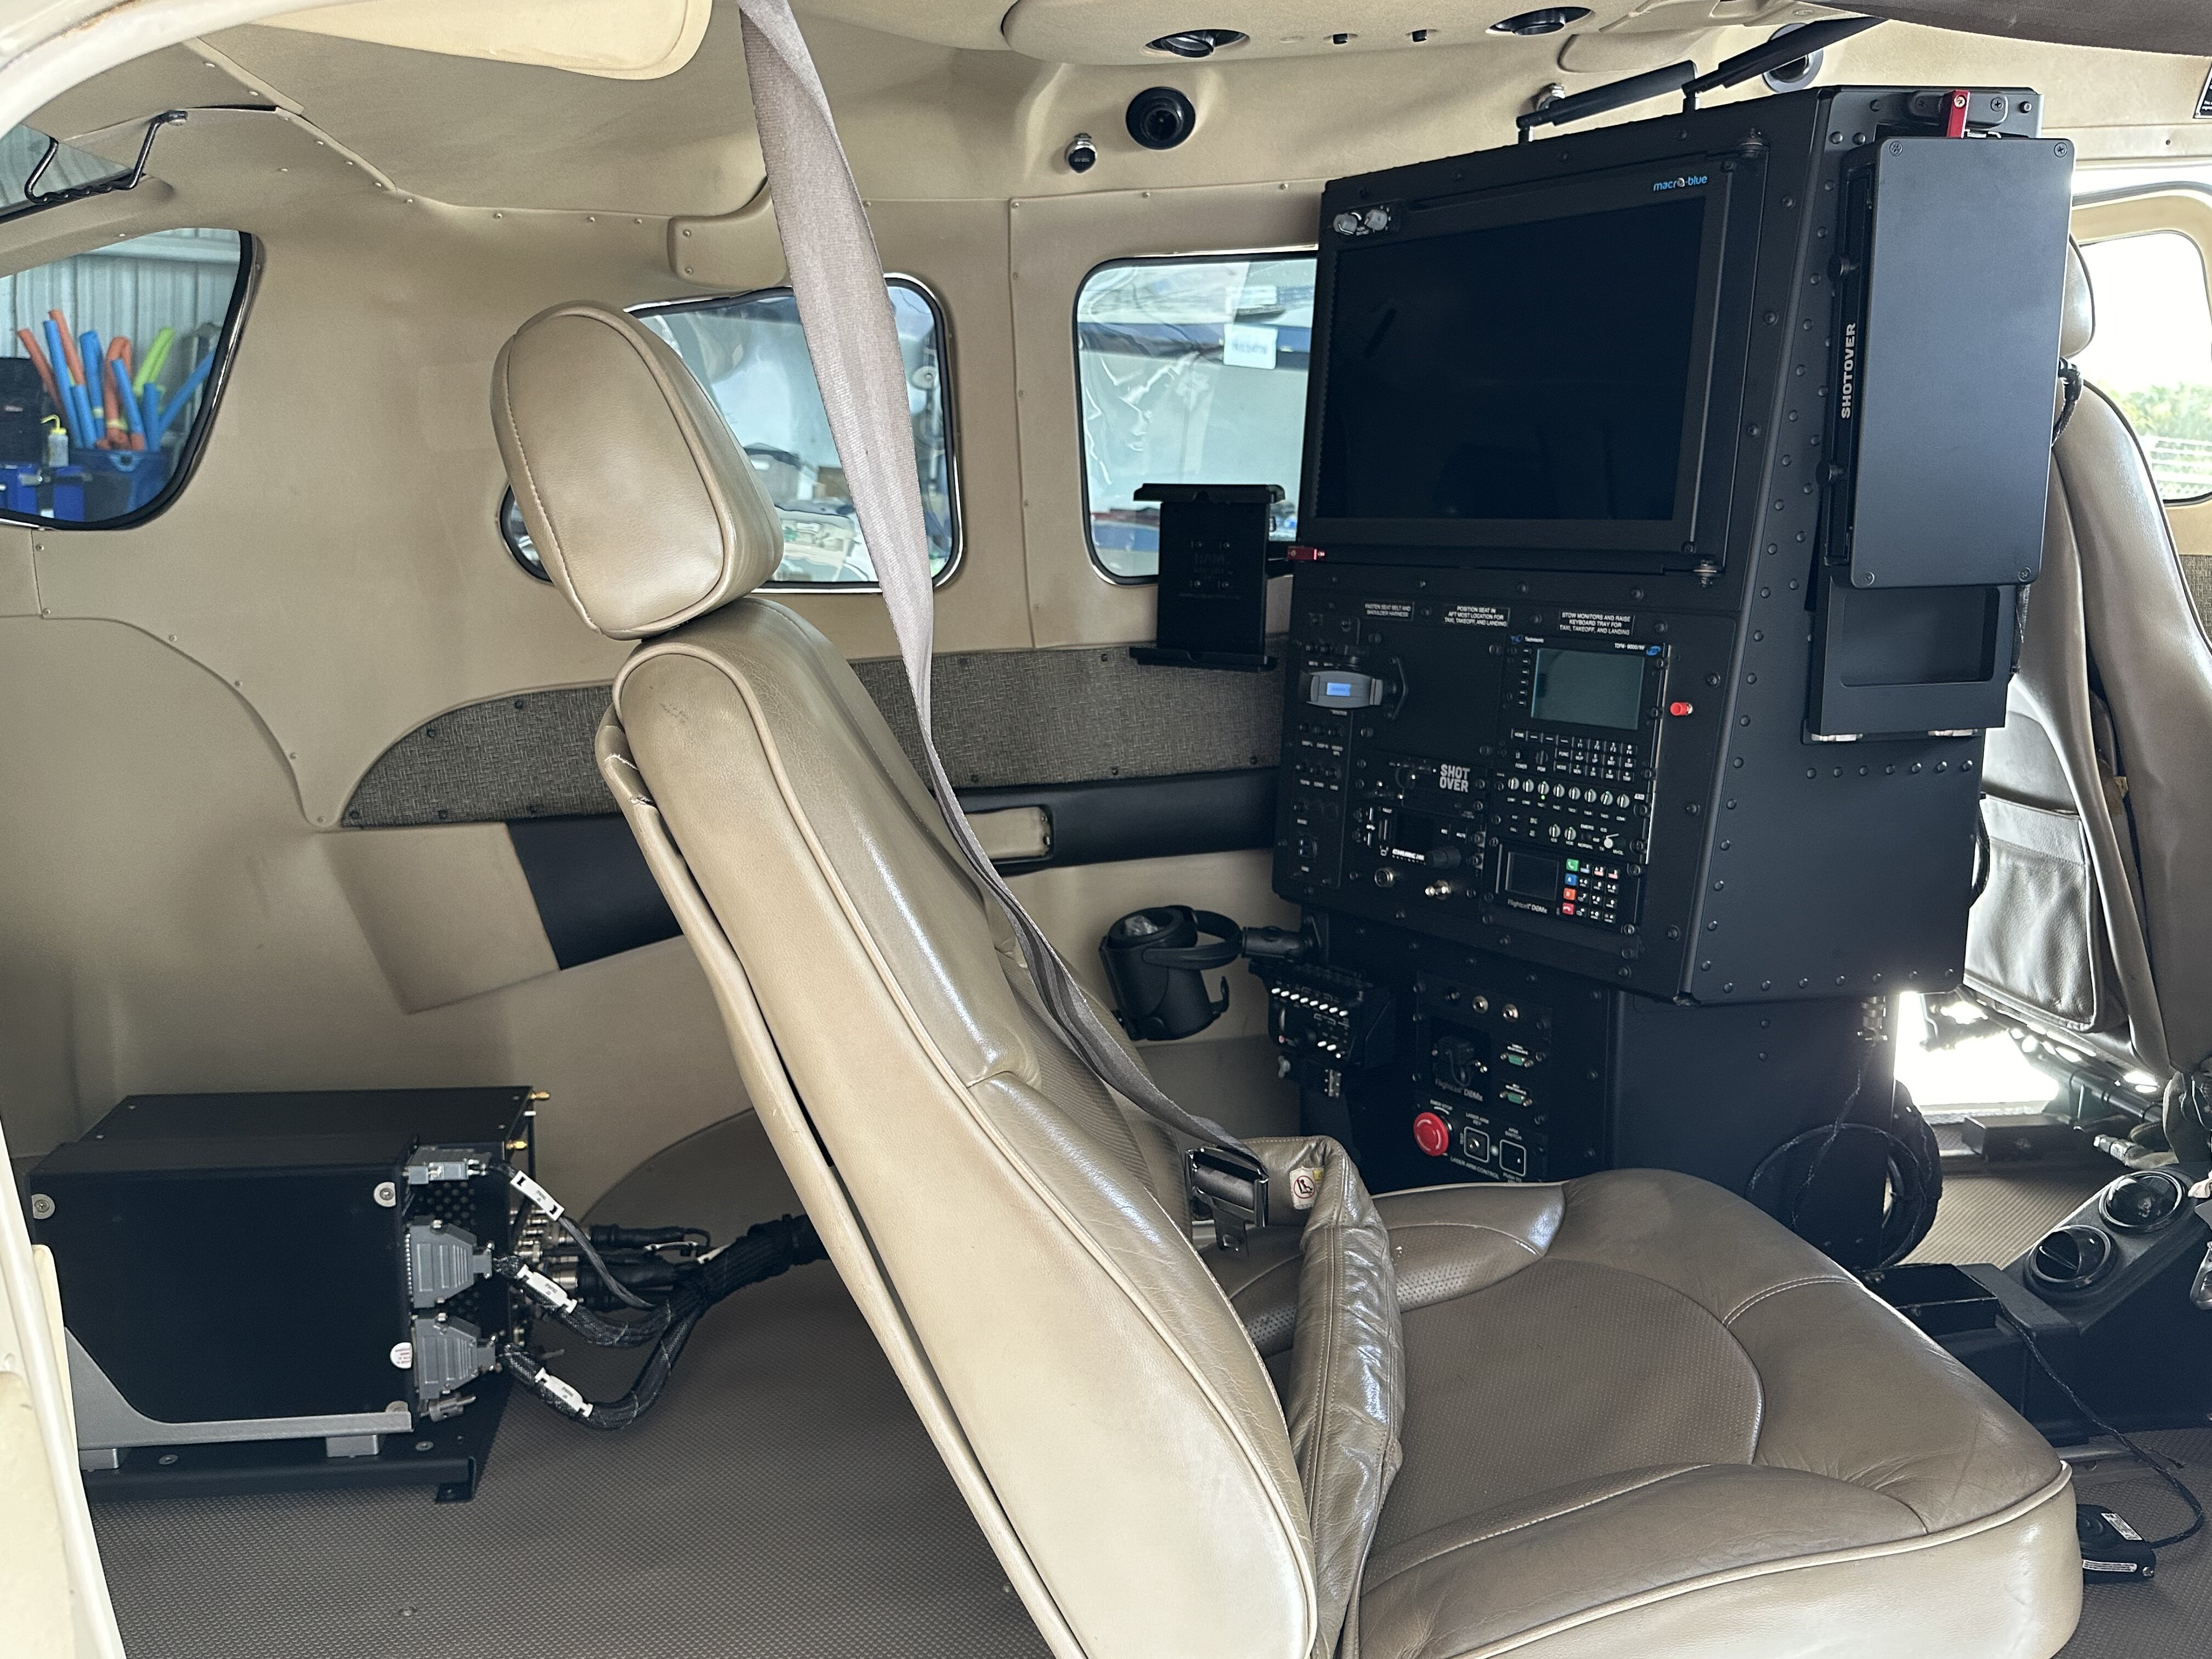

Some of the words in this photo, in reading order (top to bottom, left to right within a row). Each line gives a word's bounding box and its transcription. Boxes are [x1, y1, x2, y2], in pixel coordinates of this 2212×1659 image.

[1841, 323, 1856, 419] SHOTOVER
[1440, 764, 1470, 780] SHOT
[1440, 776, 1469, 793] OVER
[1450, 1155, 1466, 1166] LASER
[1465, 1162, 1477, 1171] ARM
[1476, 1166, 1500, 1181] CONTROL
